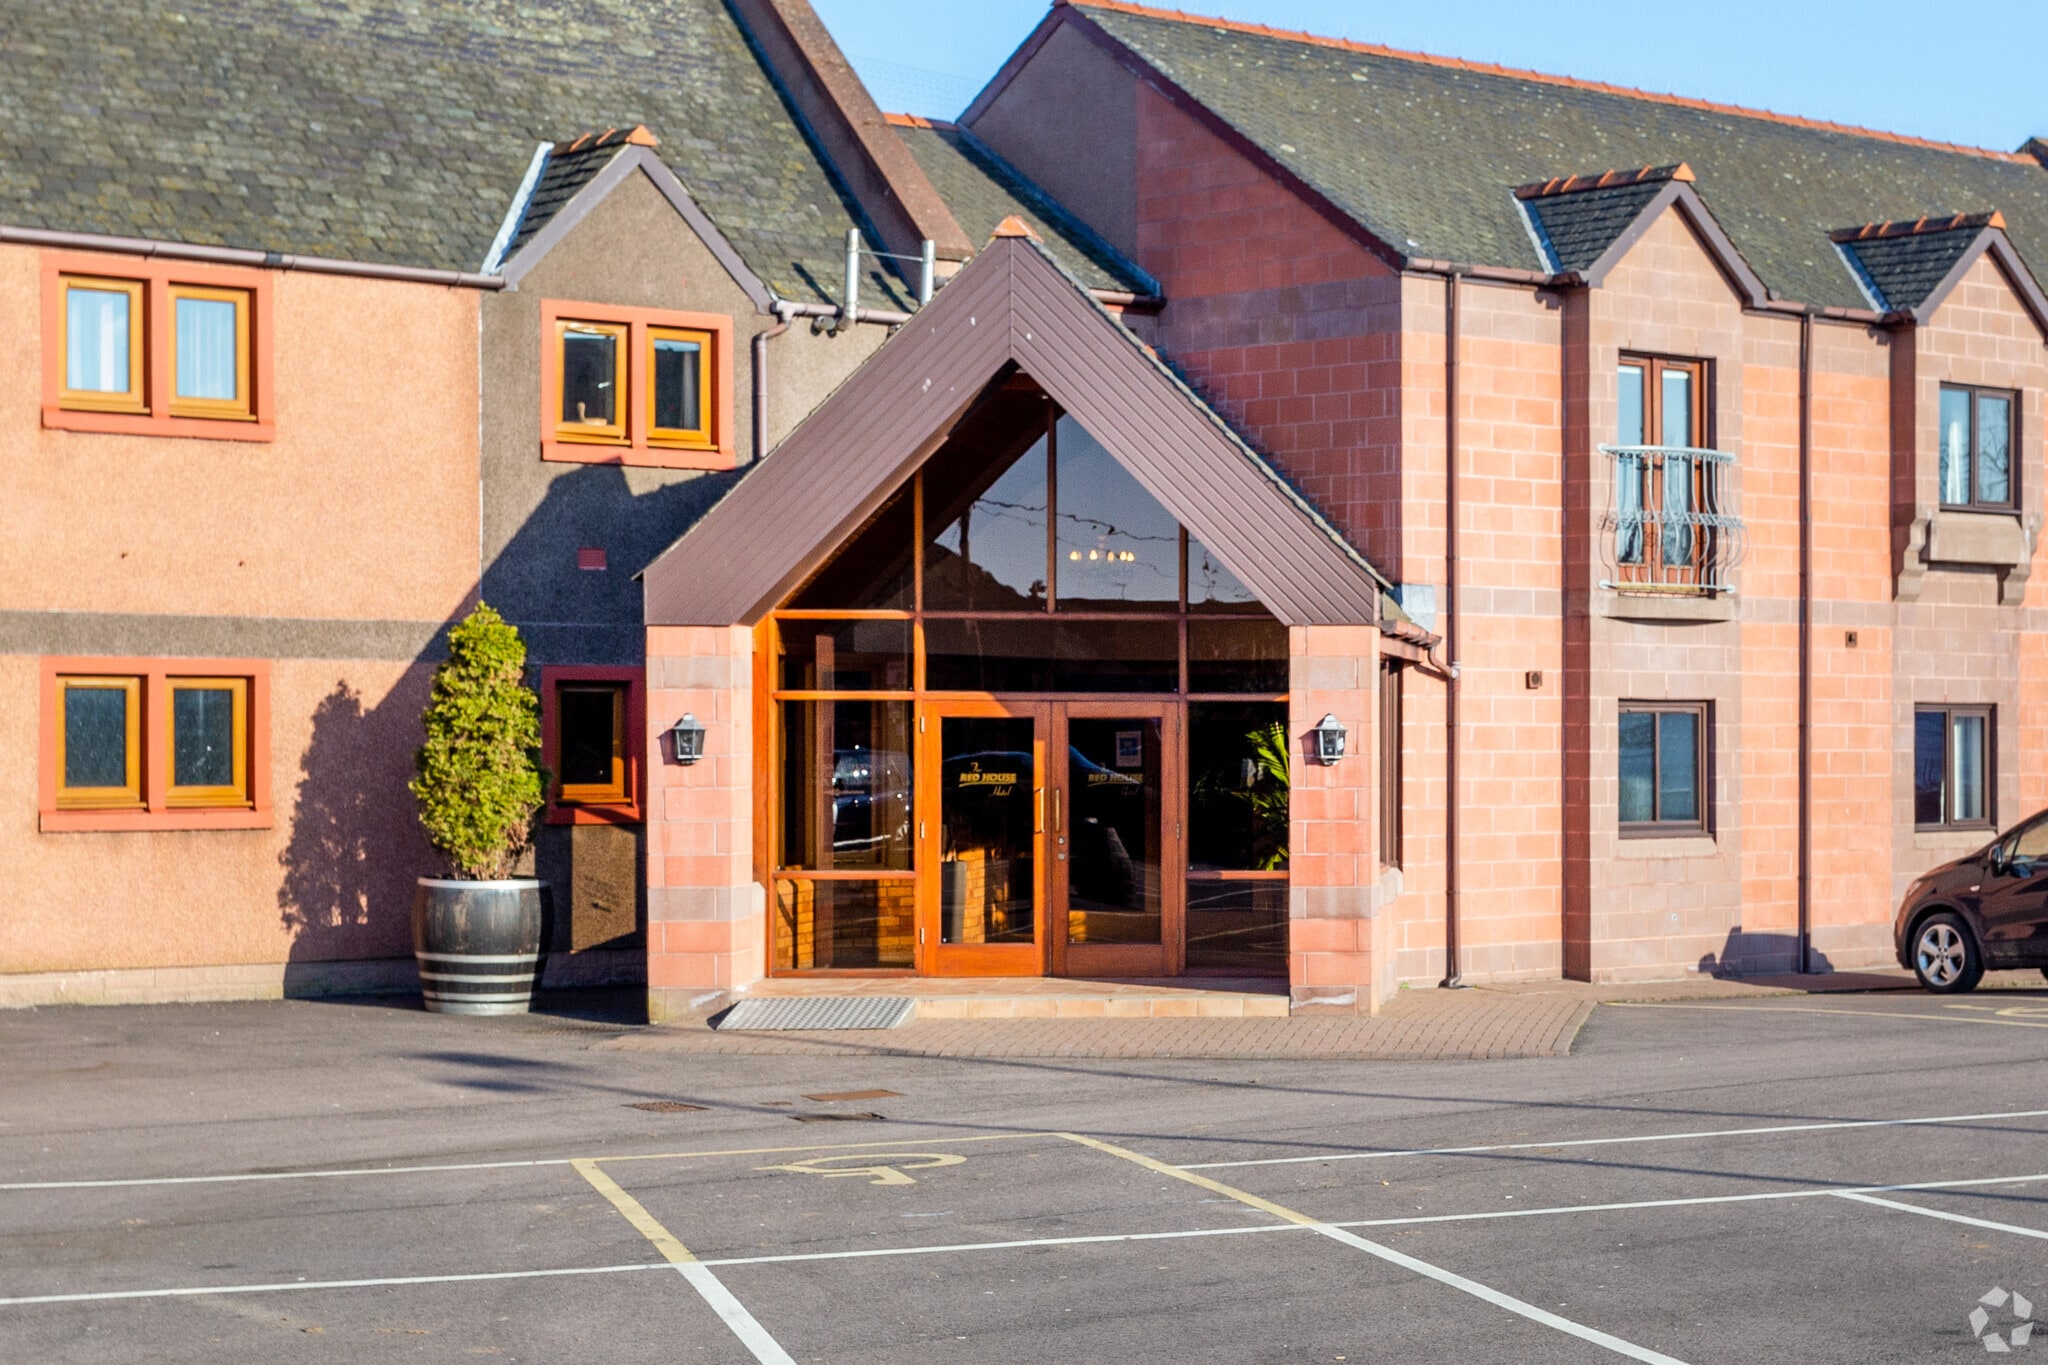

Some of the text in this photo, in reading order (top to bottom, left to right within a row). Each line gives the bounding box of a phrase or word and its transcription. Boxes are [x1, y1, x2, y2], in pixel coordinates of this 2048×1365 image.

[959, 772, 1017, 784] RED HOUSE
[1087, 772, 1108, 782] RED
